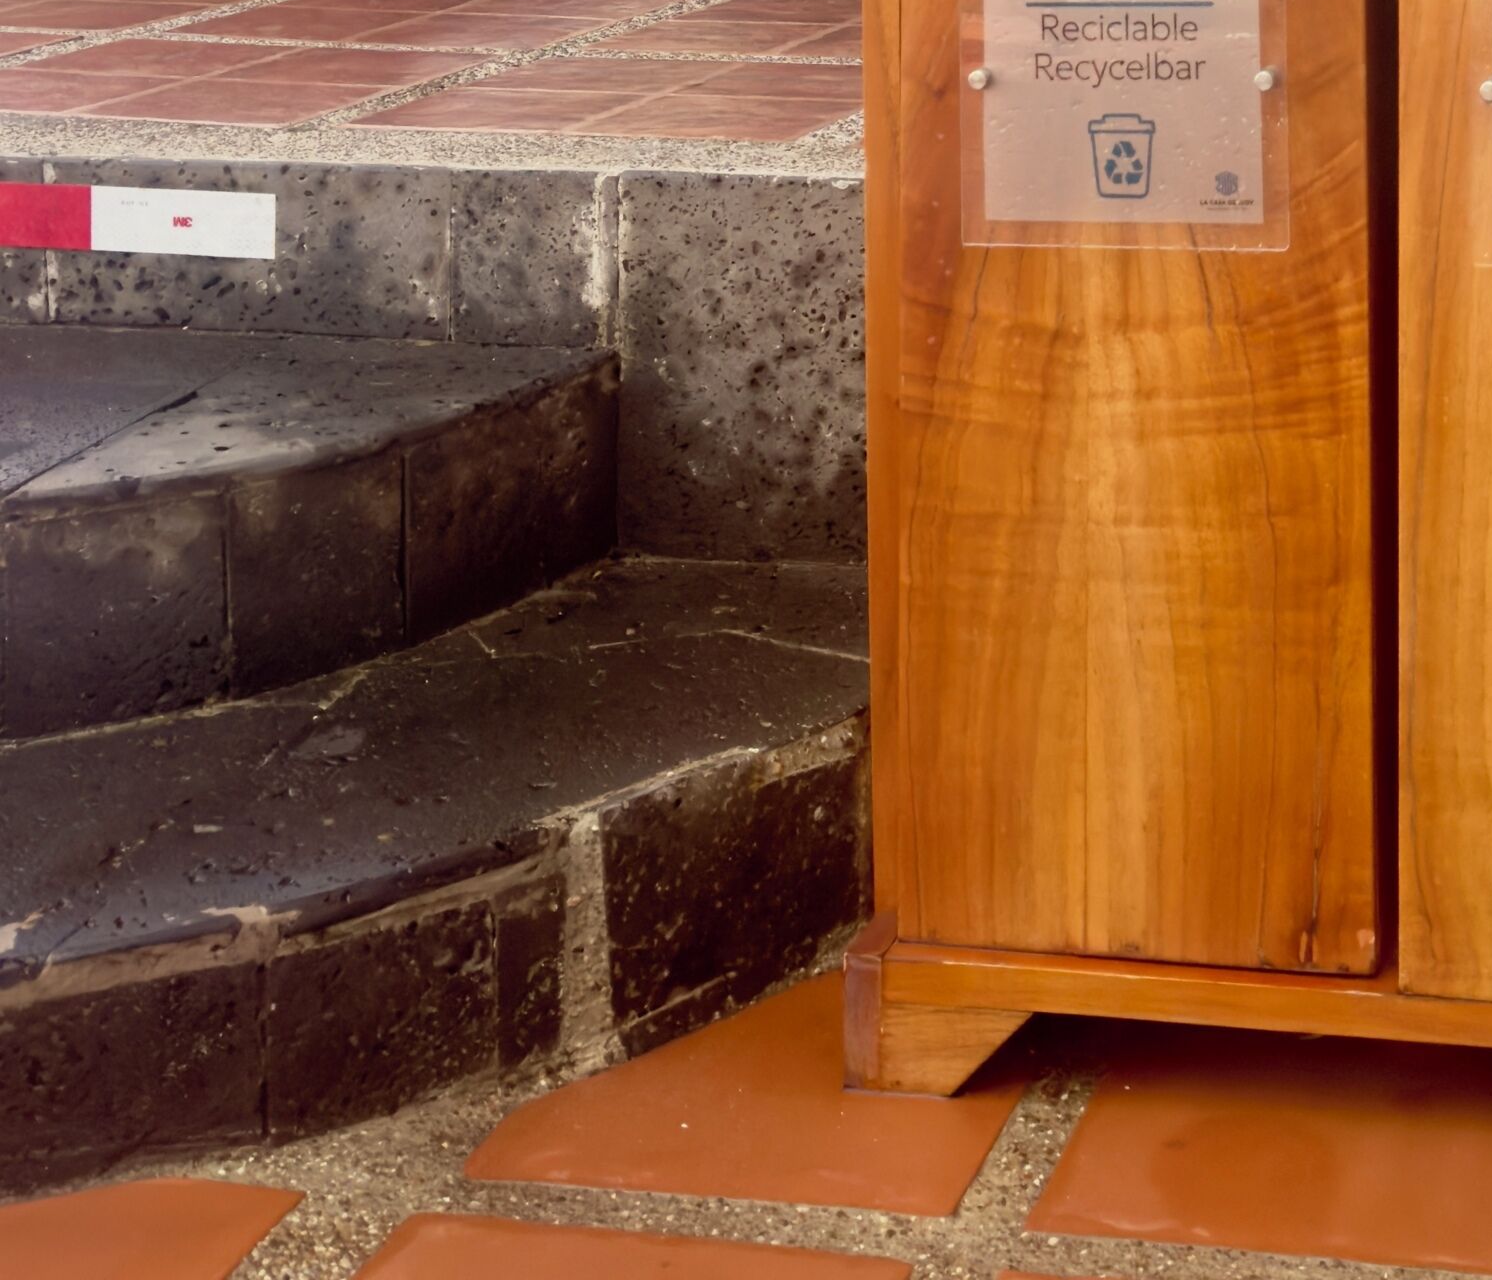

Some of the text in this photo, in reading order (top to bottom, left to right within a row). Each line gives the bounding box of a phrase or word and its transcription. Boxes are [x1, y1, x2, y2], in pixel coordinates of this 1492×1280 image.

[1040, 13, 1199, 43] Reciclable
[1034, 52, 1207, 88] Recycelbar
[173, 216, 193, 228] 3M
